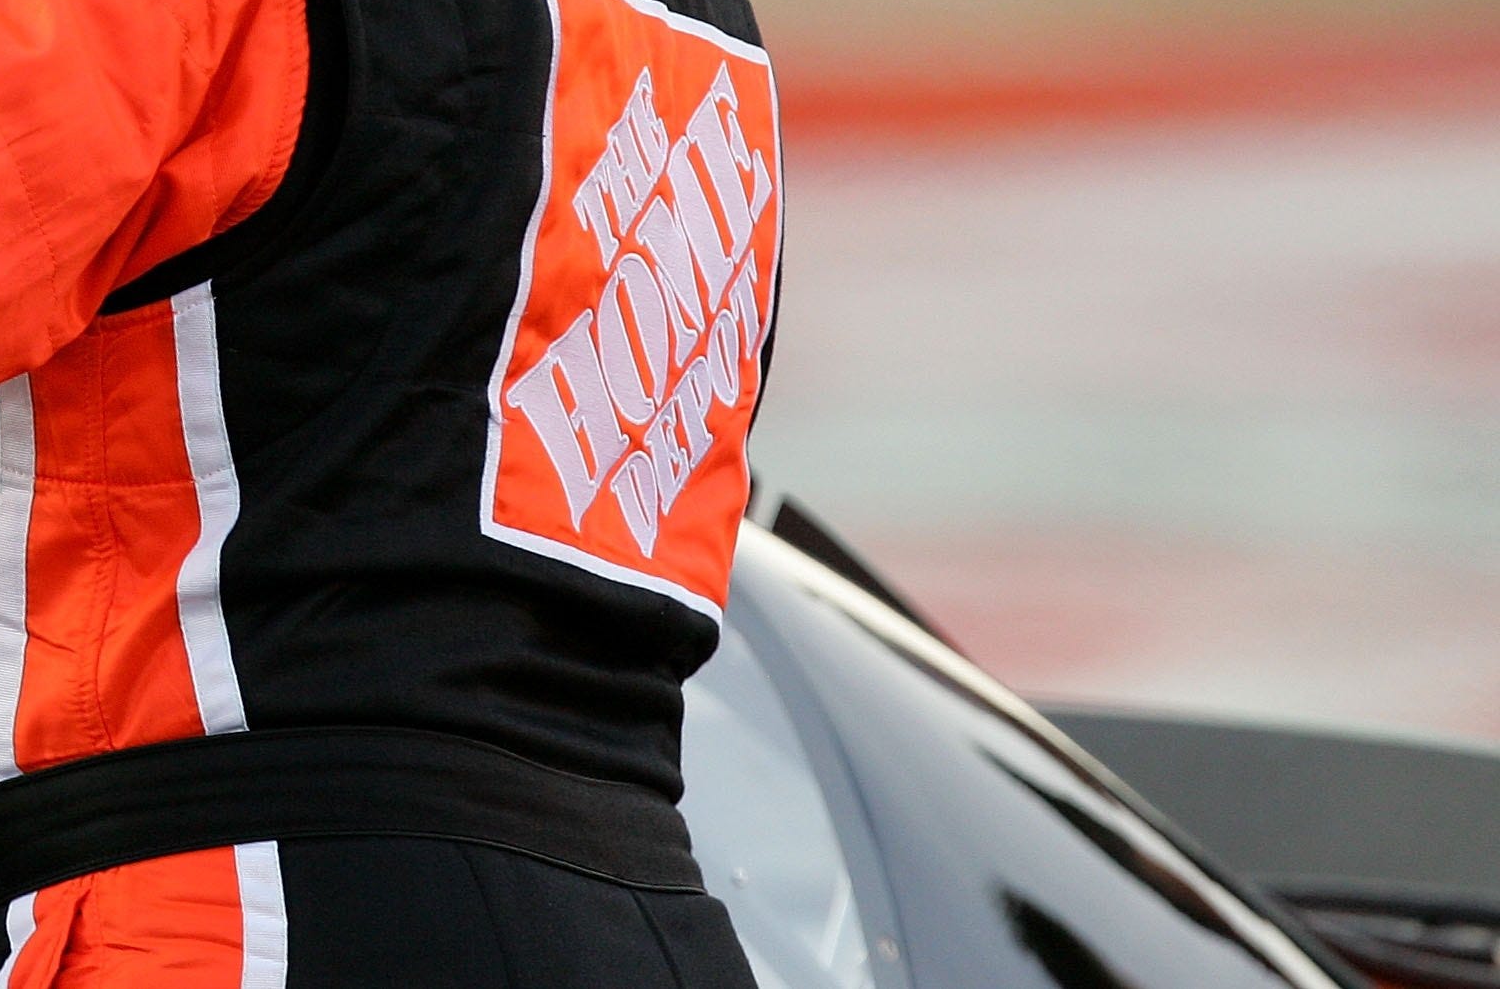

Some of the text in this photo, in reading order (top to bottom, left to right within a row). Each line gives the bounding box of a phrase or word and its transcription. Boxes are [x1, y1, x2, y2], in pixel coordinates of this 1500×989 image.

[507, 60, 773, 533] HOME
[572, 66, 669, 271] THE
[610, 256, 761, 558] DEPOT
